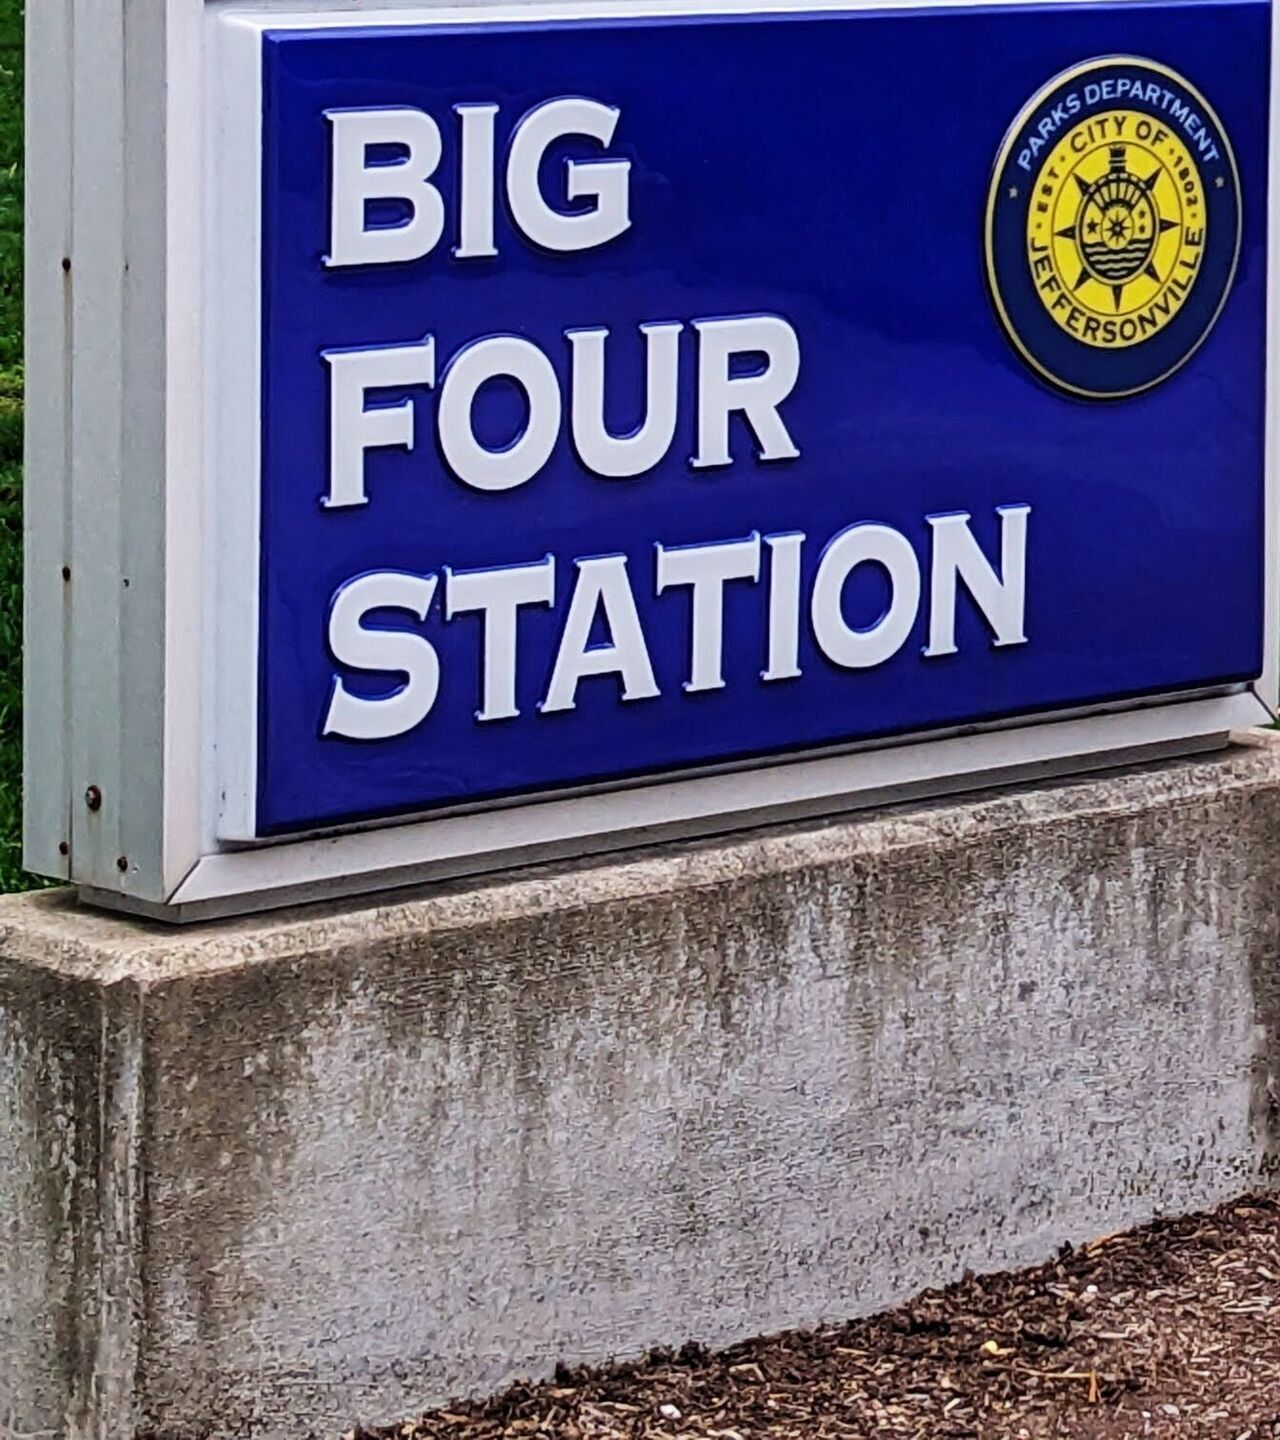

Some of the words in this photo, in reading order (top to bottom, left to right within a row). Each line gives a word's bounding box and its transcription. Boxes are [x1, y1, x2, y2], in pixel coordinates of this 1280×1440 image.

[1017, 92, 1082, 172] PARKS
[1084, 78, 1221, 164] DEPARTMENT
[1070, 115, 1129, 154] CITY
[1136, 119, 1169, 146] OF
[322, 97, 633, 268] BIG
[1037, 170, 1060, 216] EST
[1172, 153, 1199, 210] 1802
[1031, 227, 1204, 344] JEFFERSONVILLE
[320, 315, 800, 510] FOUR
[322, 505, 1034, 740] STATION
